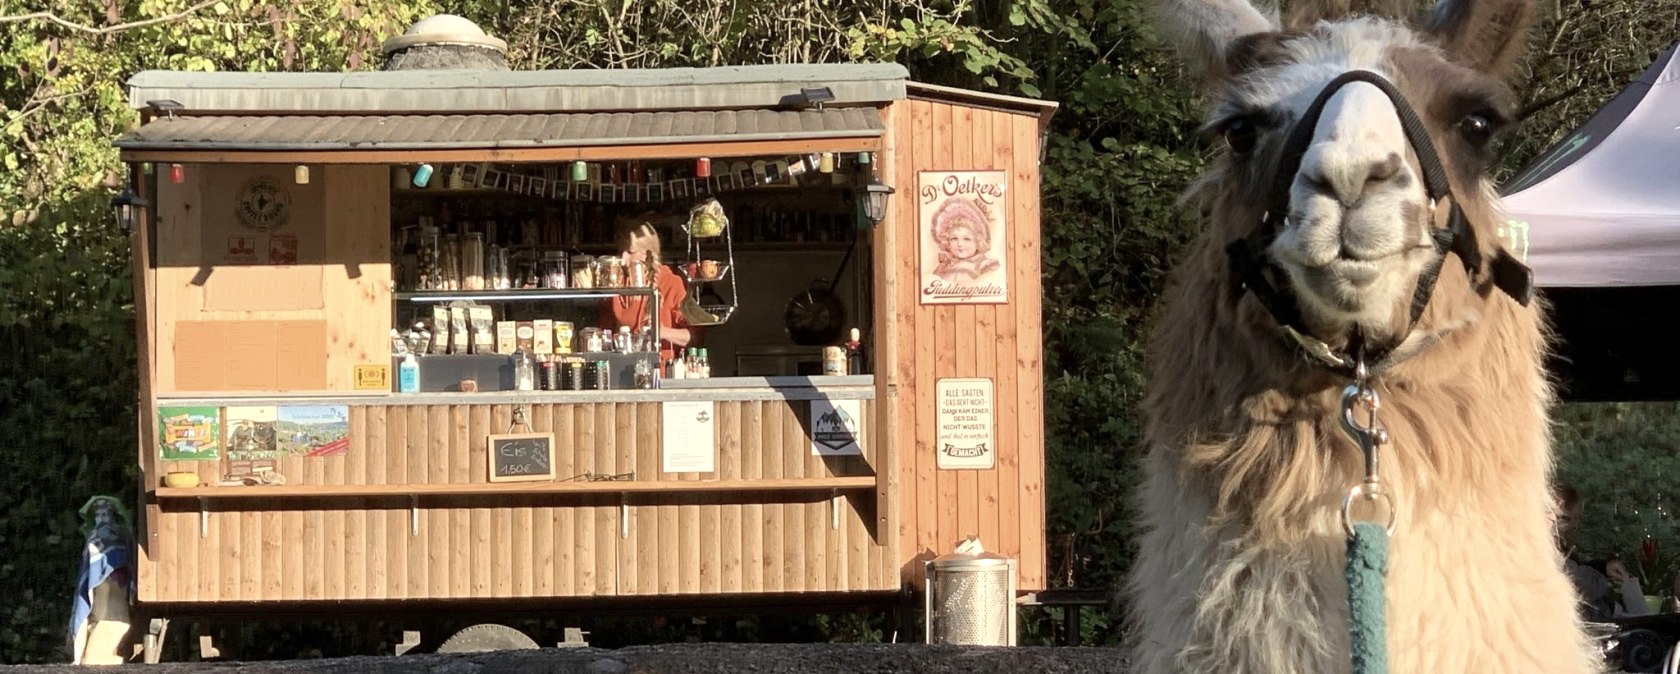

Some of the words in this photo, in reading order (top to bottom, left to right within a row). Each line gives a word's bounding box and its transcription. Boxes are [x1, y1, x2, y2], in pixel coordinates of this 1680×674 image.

[945, 389, 959, 397] ALLE
[961, 388, 984, 397] SAGTEN
[501, 442, 527, 457] Eis
[950, 446, 982, 456] GEMACHT
